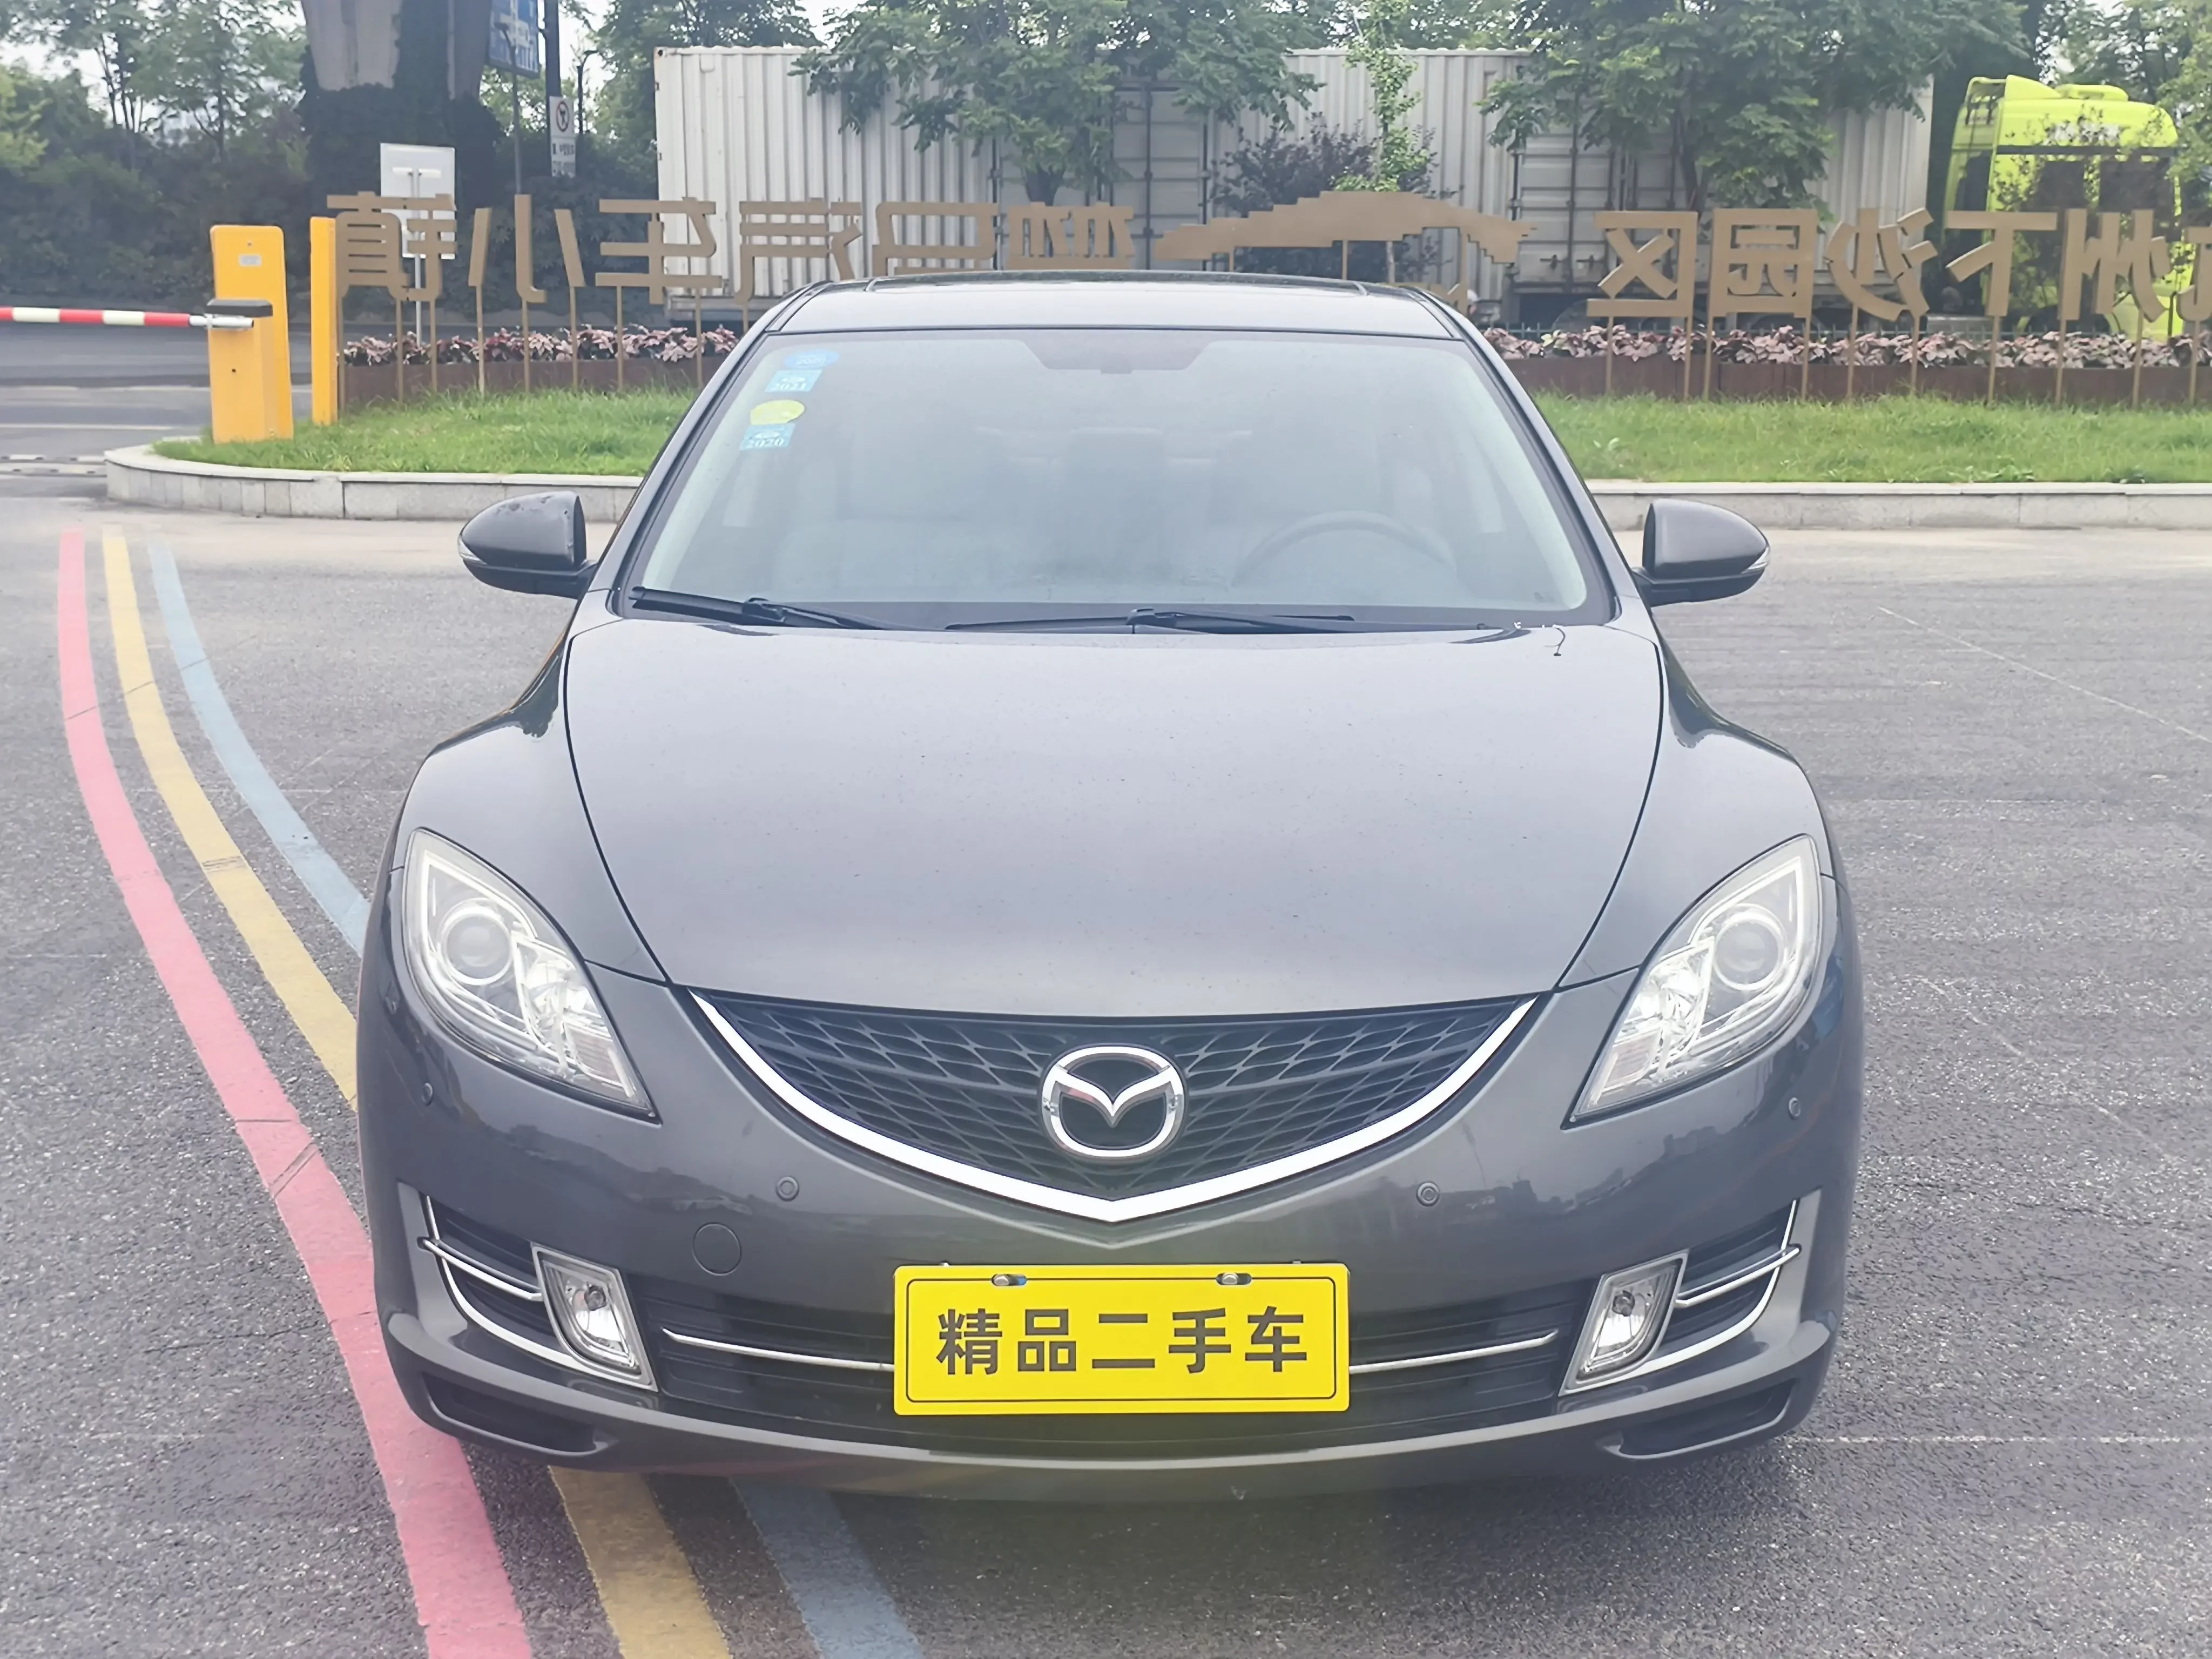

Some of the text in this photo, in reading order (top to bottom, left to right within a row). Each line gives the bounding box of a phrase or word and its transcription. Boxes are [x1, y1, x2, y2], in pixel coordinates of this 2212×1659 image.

[746, 437, 785, 448] 2020
[936, 1306, 1307, 1375] 精品二手车
